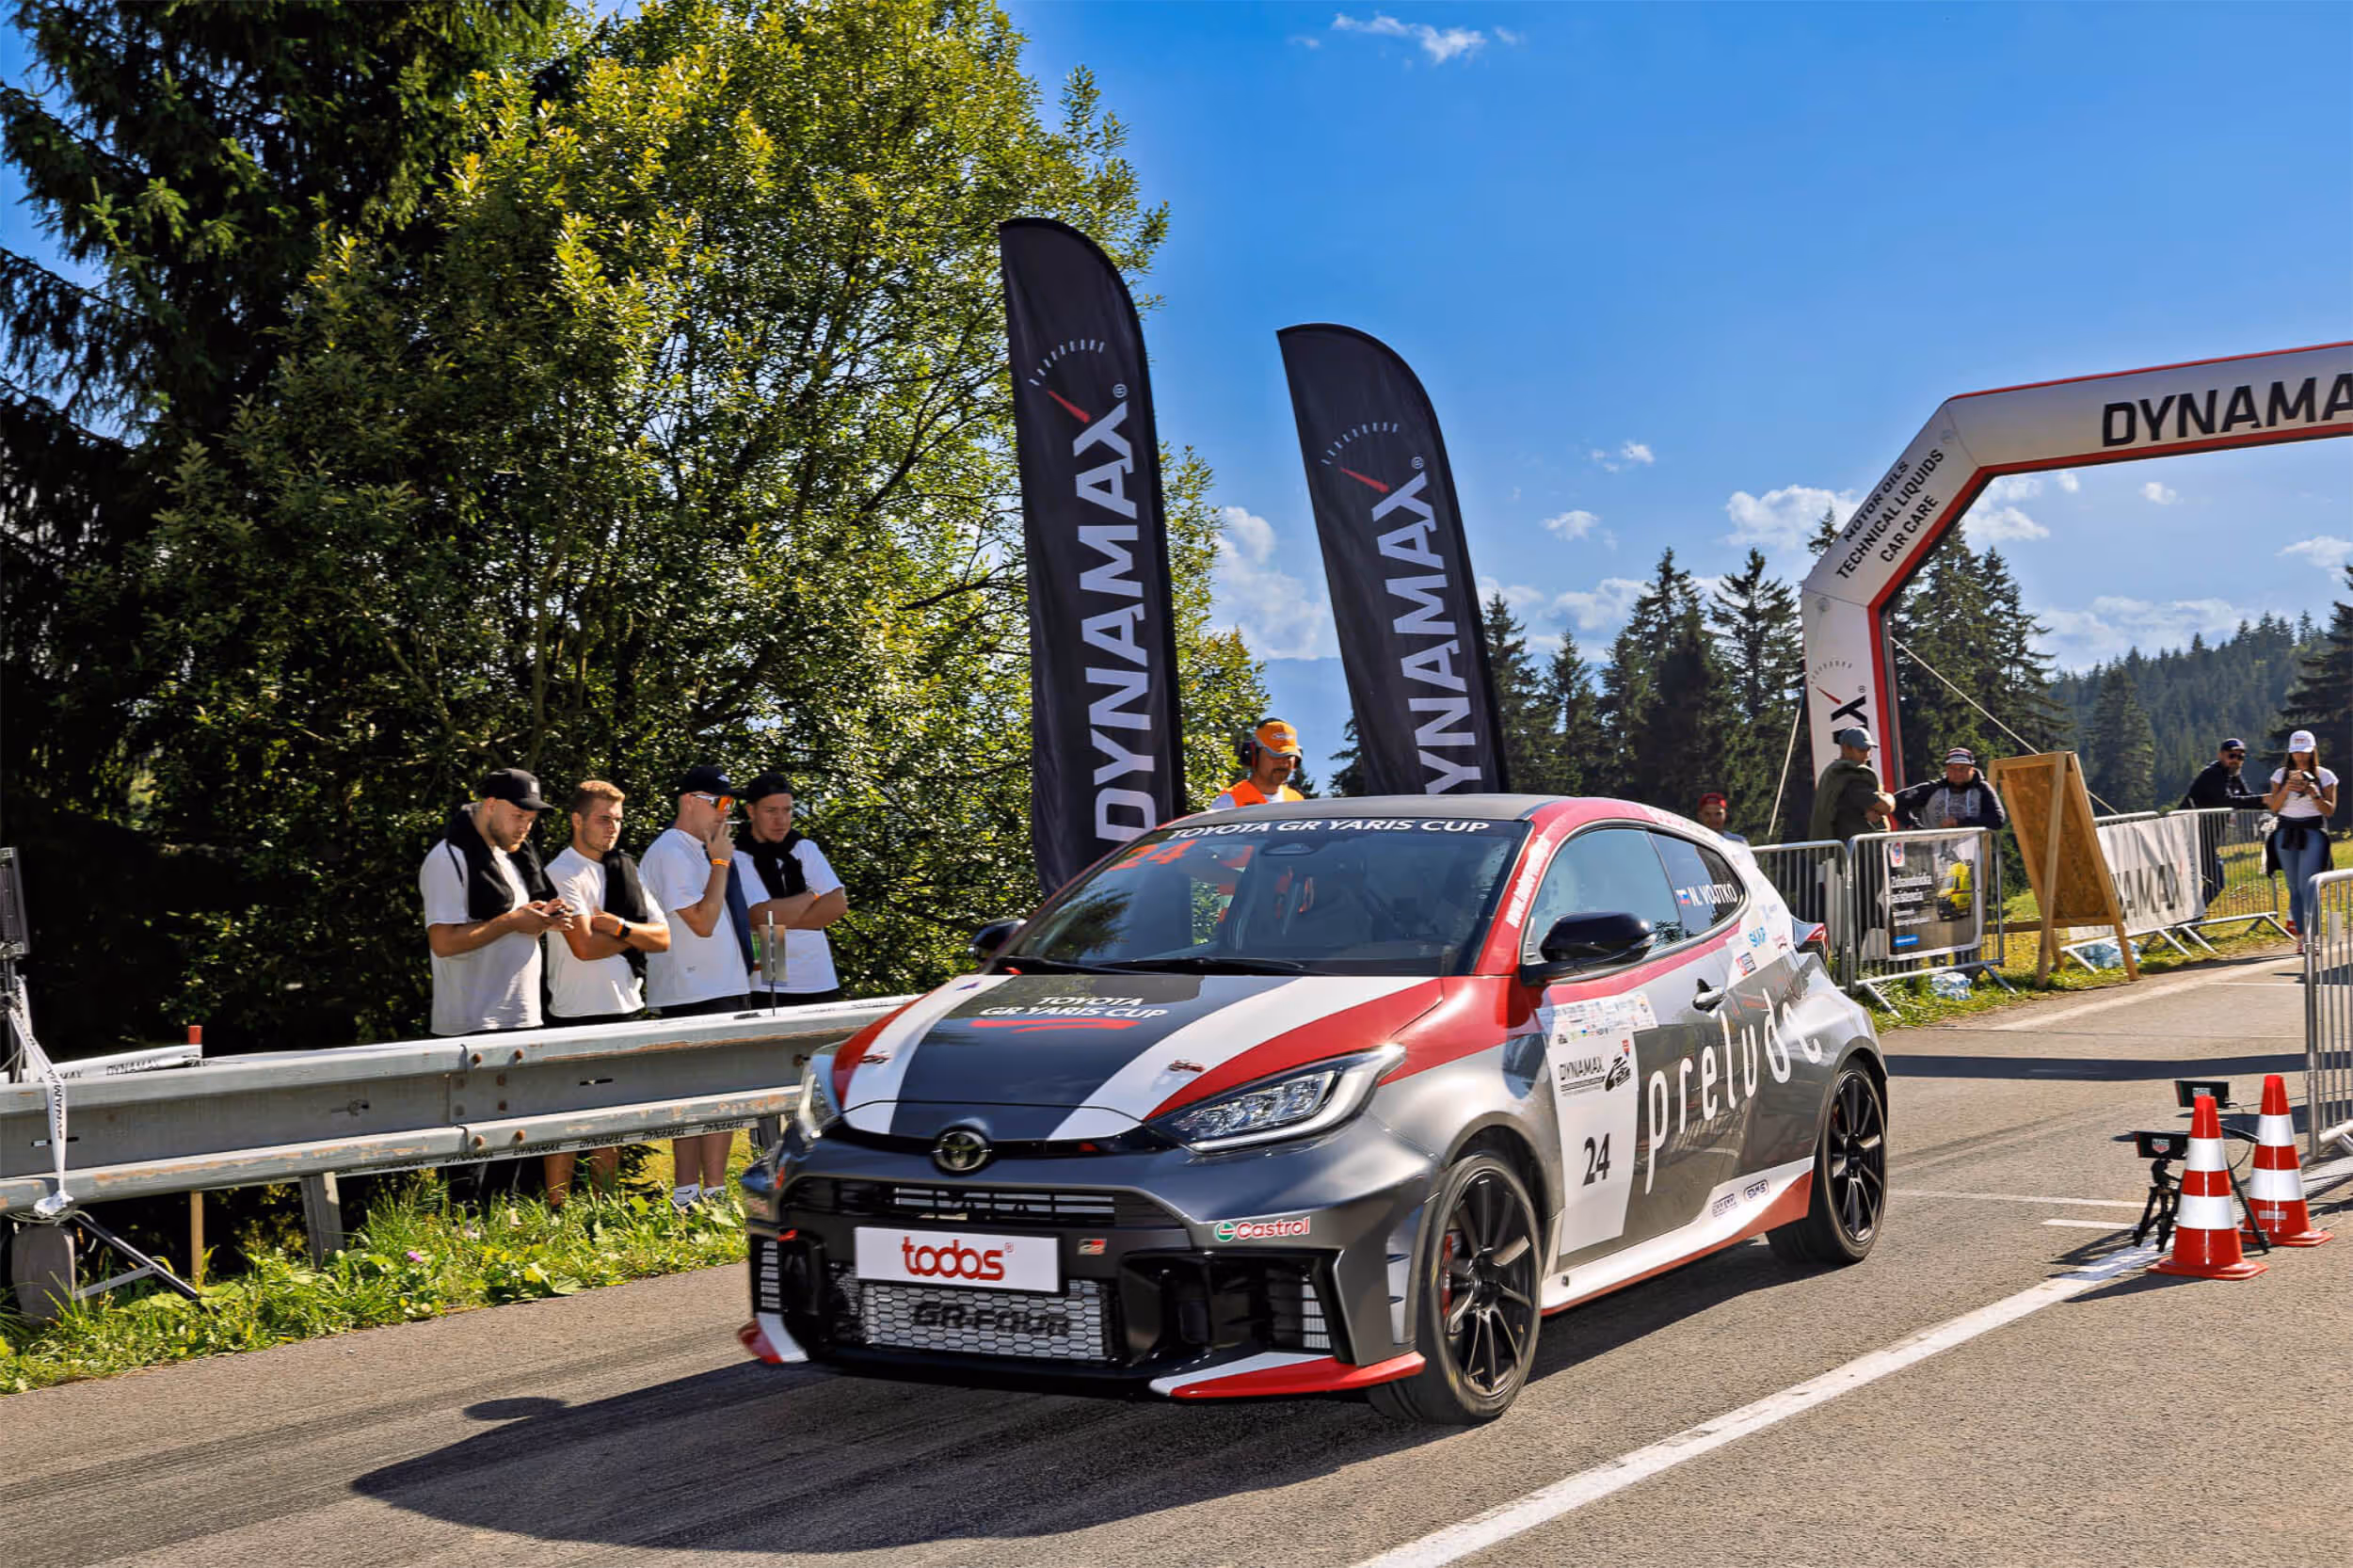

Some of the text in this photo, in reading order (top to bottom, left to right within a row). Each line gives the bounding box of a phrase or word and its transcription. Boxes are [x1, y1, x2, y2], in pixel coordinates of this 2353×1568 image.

[1835, 448, 1945, 580] TECHNICAL LIQUIDS
[1842, 459, 1911, 542] MOTOR OILS
[1880, 494, 1940, 563] CAR CARE
[1072, 400, 1158, 841] DYNAMAX
[1166, 818, 1491, 840] TOYOTA GR YARIS CUP
[1108, 840, 1197, 872] 24
[979, 1006, 1170, 1018] GR YARIS CUP
[1035, 995, 1145, 1006] TOYOTA
[1582, 1131, 1611, 1187] 24
[1236, 1215, 1311, 1240] Castrol
[902, 1235, 1005, 1281] todos
